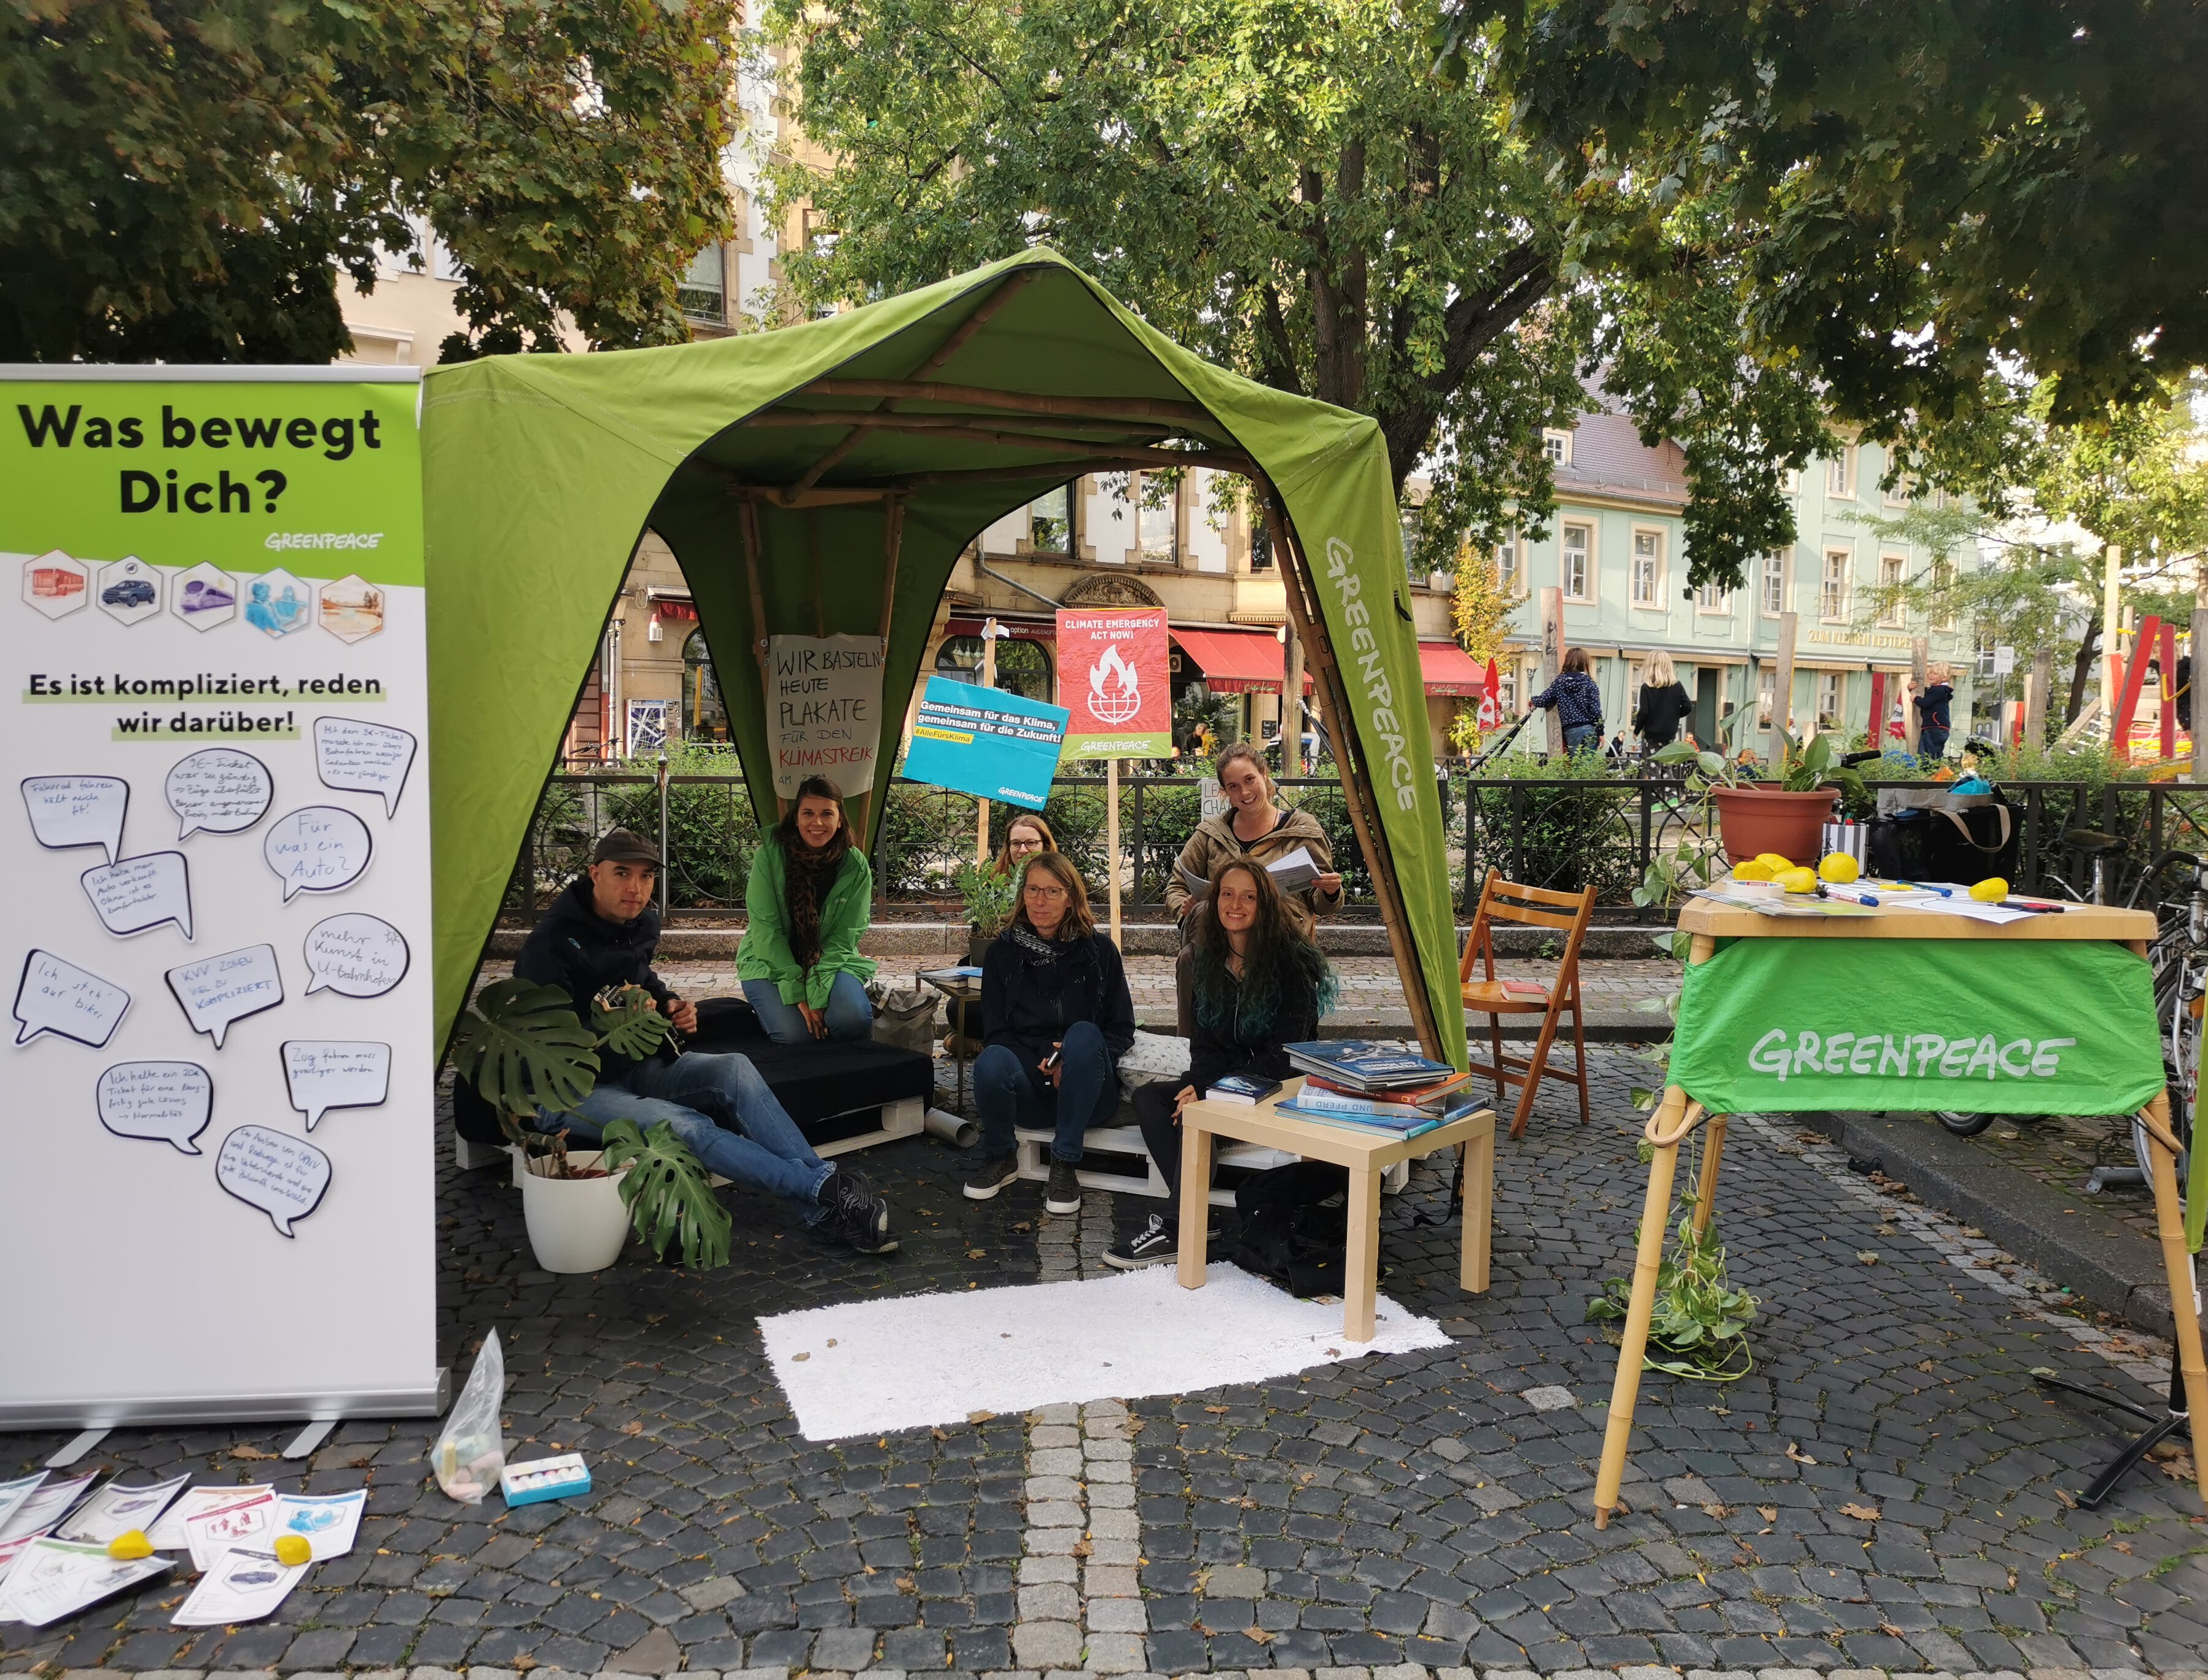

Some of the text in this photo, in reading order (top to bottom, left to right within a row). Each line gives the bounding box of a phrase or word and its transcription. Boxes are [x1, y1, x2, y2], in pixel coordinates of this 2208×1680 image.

[17, 404, 381, 461] Was bewegt
[120, 469, 288, 513] Dich?
[265, 532, 384, 551] GREENPEACE
[1065, 619, 1160, 629] CLIMATE EMERGENCY
[1090, 630, 1134, 640] ACT NOW!
[1808, 629, 1829, 643] ZUM
[1831, 631, 1869, 646] KLEINEN
[777, 650, 881, 676] WIR BASTELN
[1326, 536, 1416, 812] GREENPEACE
[30, 674, 380, 700] Es ist kompliziert, reden
[781, 678, 829, 696] HEUTE
[117, 711, 294, 733] wir darüber!
[779, 699, 867, 729] PLAKATE
[921, 701, 1056, 731] Gemeinsam für das Klima,
[324, 725, 338, 734] Mit
[779, 727, 852, 744] FÜR DEN
[915, 728, 970, 742] #AlleFürsKlima
[918, 714, 1061, 743] gemeinsam für die Zukunft!
[1080, 740, 1151, 752] GREENPEACE
[779, 746, 873, 768] KLIMASTREIK
[778, 775, 792, 785] AM
[998, 787, 1045, 803] GREENPEACE
[298, 814, 332, 835] Für
[275, 838, 344, 854] was ein
[291, 857, 351, 878] Auto?
[92, 876, 107, 885] Ich
[320, 930, 371, 945] mehr
[314, 940, 389, 966] Kunst in
[38, 961, 58, 980] Ich
[181, 964, 210, 981] KVV
[42, 986, 66, 998] auf
[292, 1047, 317, 1067] Zug
[1748, 1029, 2077, 1081] GREENPEACE
[109, 1071, 127, 1084] Ich
[1316, 1101, 1347, 1110] PFERD
